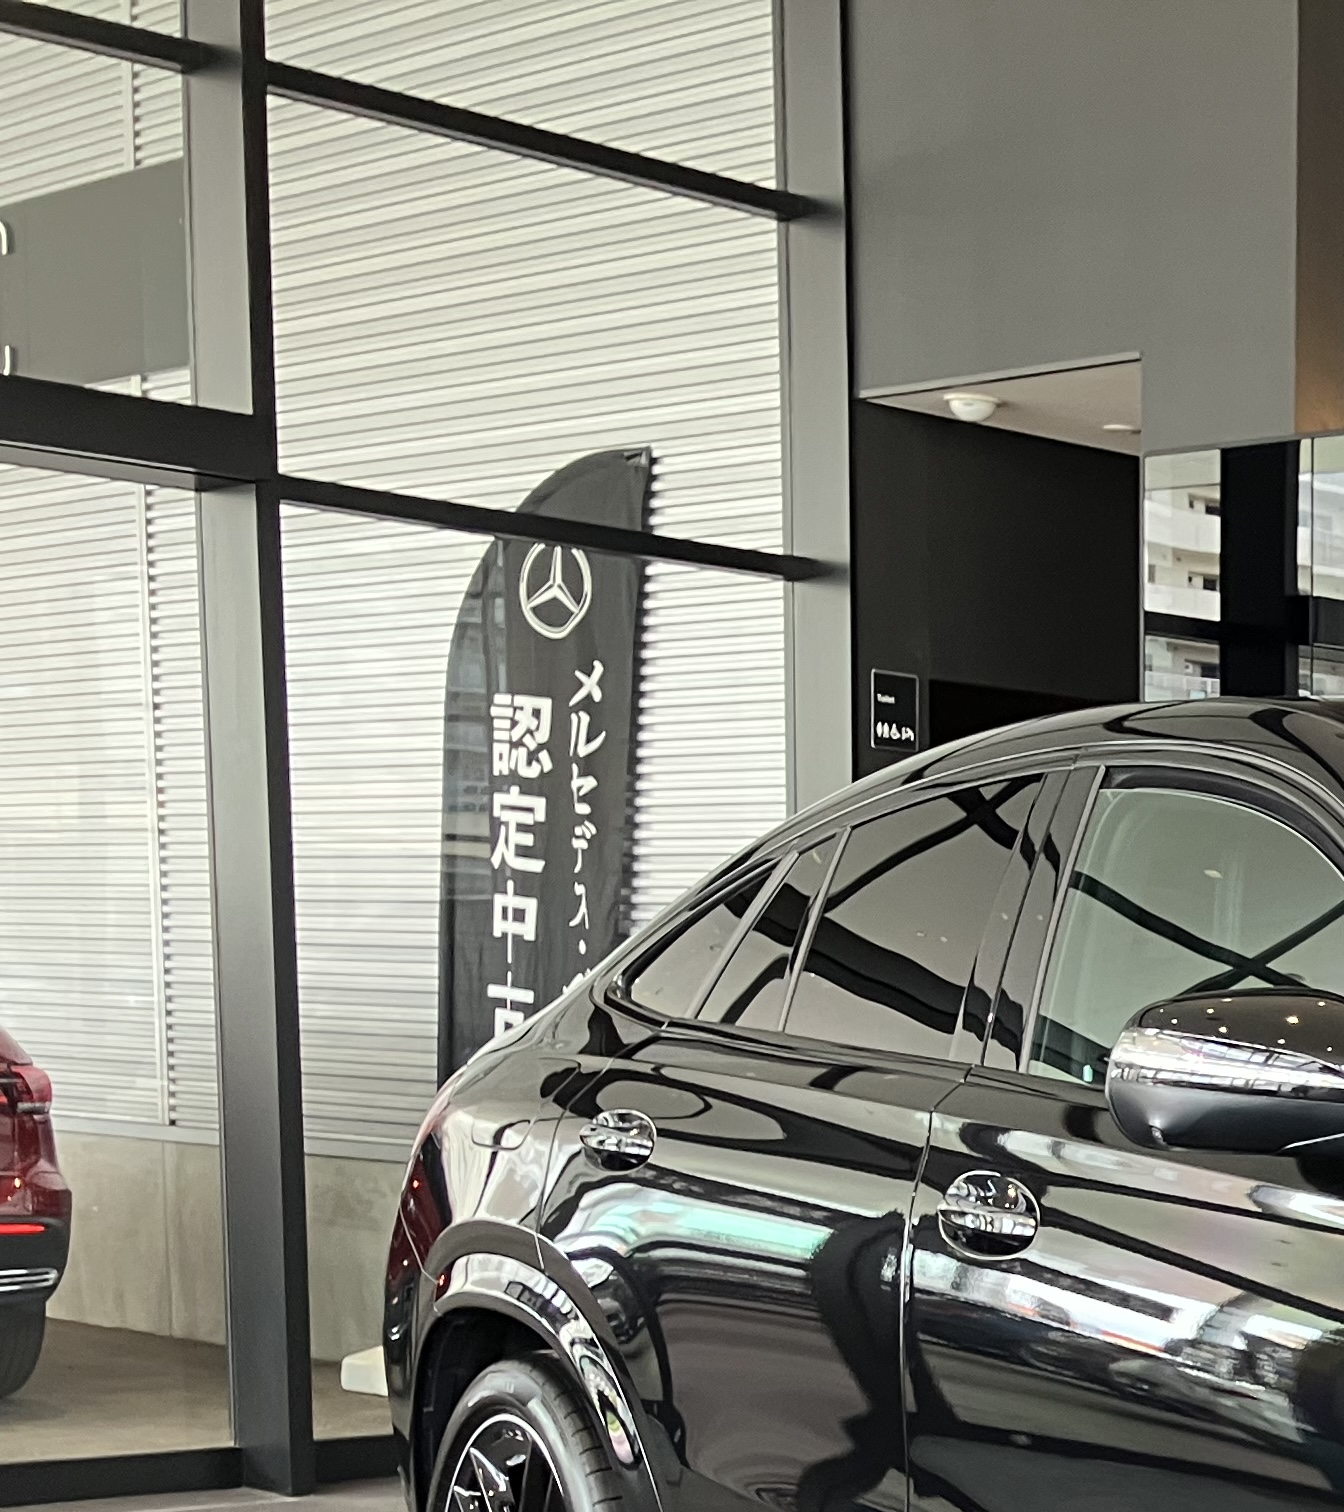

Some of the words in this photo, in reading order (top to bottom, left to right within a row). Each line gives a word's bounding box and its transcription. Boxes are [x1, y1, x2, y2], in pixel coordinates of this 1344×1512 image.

[562, 659, 606, 995] メルセデス・
